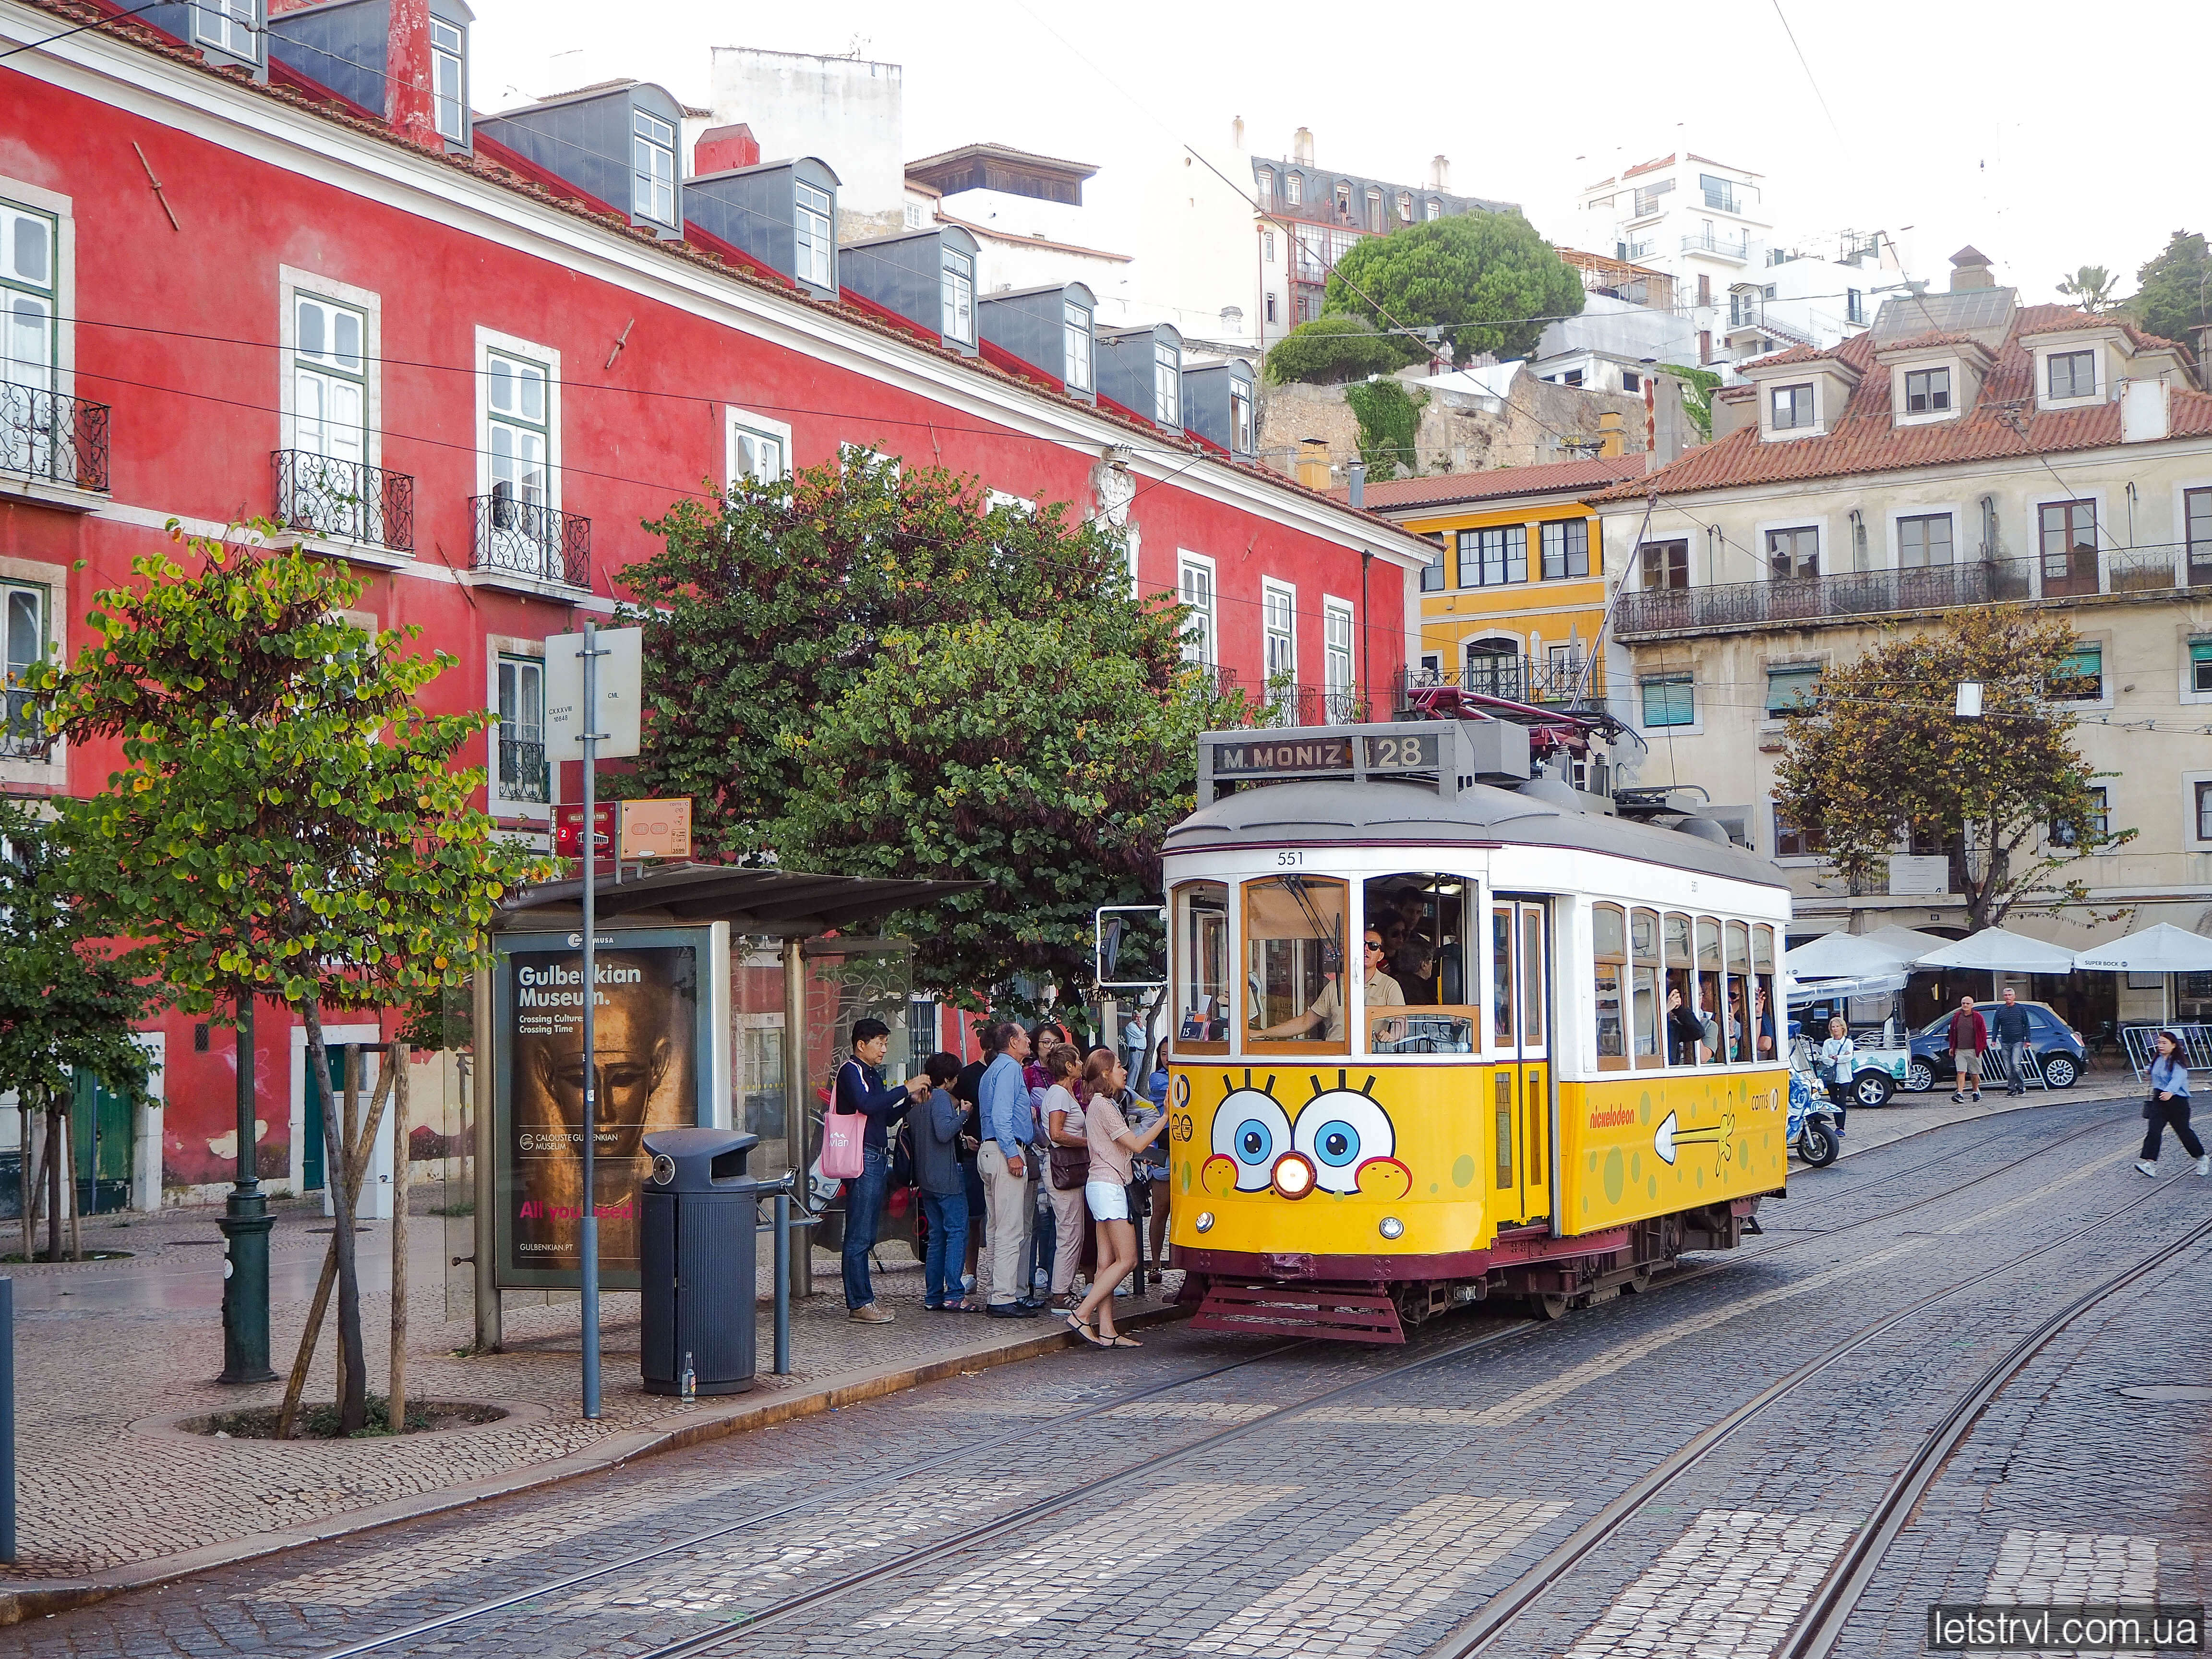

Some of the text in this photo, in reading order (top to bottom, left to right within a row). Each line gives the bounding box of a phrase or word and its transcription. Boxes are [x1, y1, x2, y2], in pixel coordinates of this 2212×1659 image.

[549, 706, 572, 715] CXXXVIII
[1224, 745, 1341, 768] M. MONIZ
[1378, 737, 1421, 767] 28
[561, 830, 566, 838] 2
[1278, 852, 1302, 865] 551
[519, 964, 641, 986] Gulbekian
[519, 1015, 552, 1024] Crossing
[519, 1025, 574, 1035] Crossing Time
[1182, 1028, 1190, 1036] 15
[1752, 1087, 1768, 1111] carris
[1589, 1103, 1635, 1129] nickelodeon
[830, 1138, 849, 1147] vian
[520, 1201, 543, 1218] All
[548, 1206, 581, 1223] you
